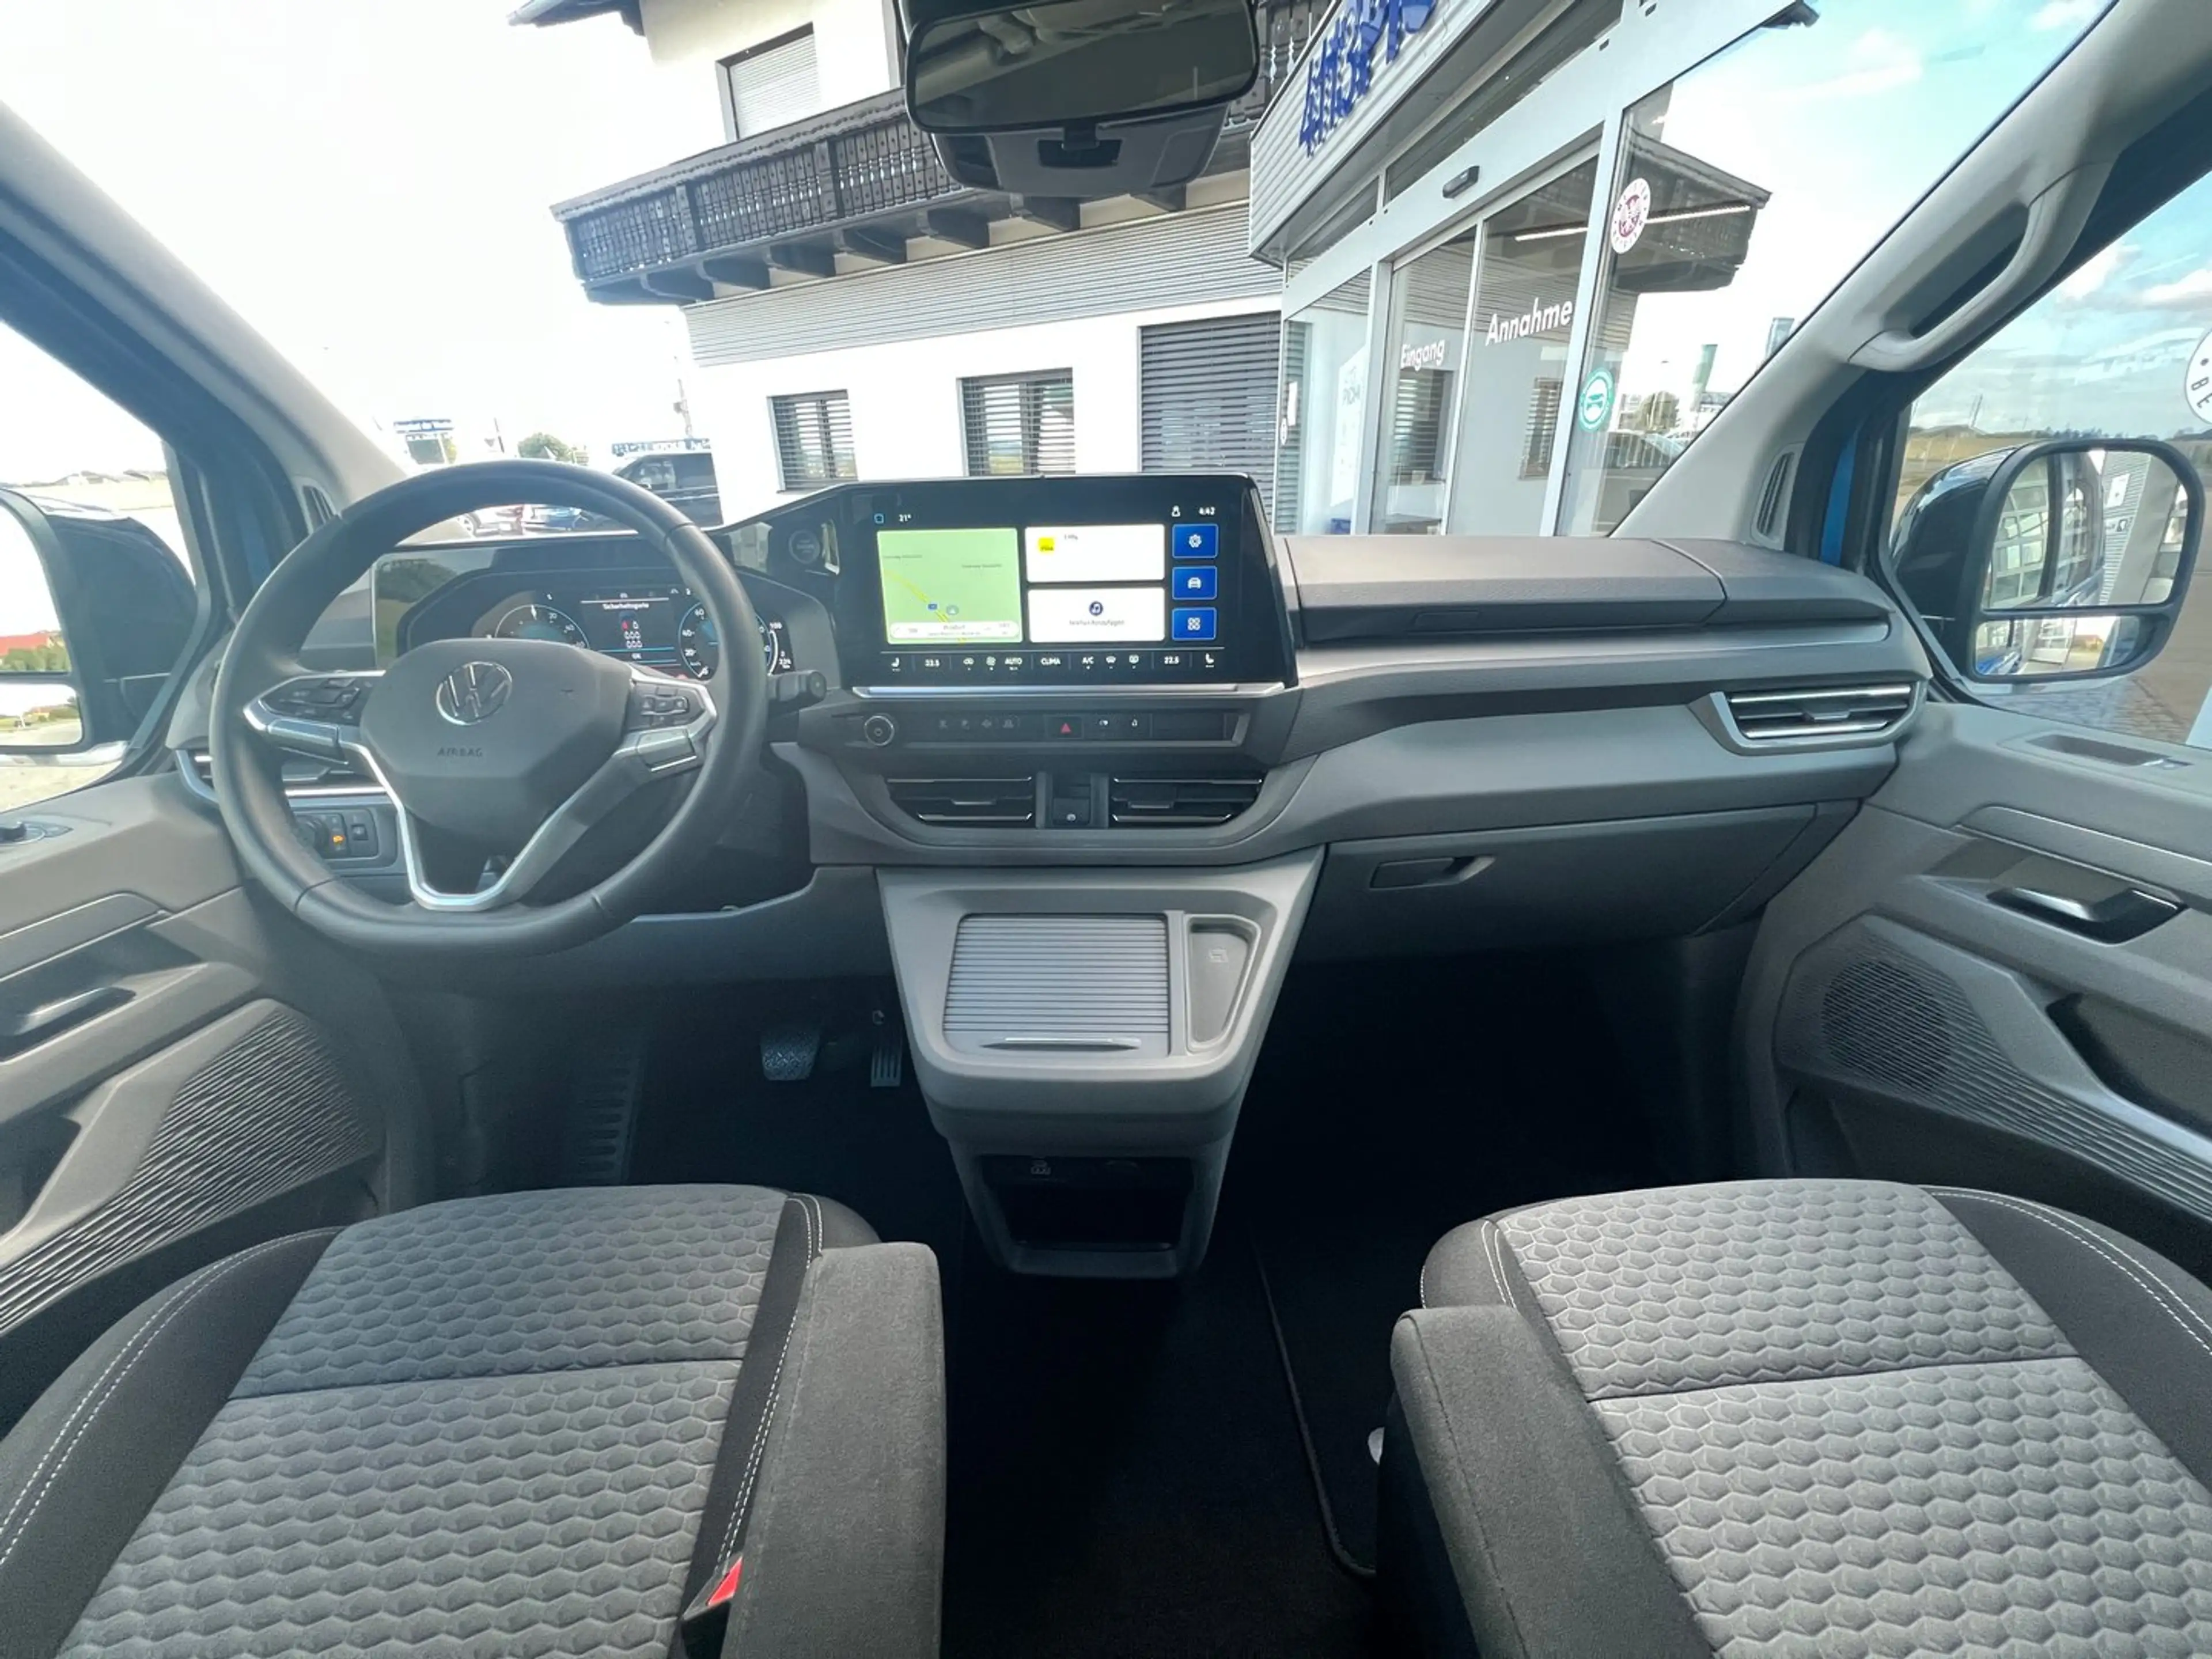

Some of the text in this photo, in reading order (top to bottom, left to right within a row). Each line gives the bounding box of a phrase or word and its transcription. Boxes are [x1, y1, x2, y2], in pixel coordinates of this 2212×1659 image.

[1485, 297, 1573, 347] Annahme
[1400, 340, 1445, 371] Eingang
[1005, 657, 1022, 665] AUTO
[1040, 657, 1061, 666] CLIMA
[1082, 656, 1094, 665] A/C
[437, 748, 483, 757] AIRBAG
